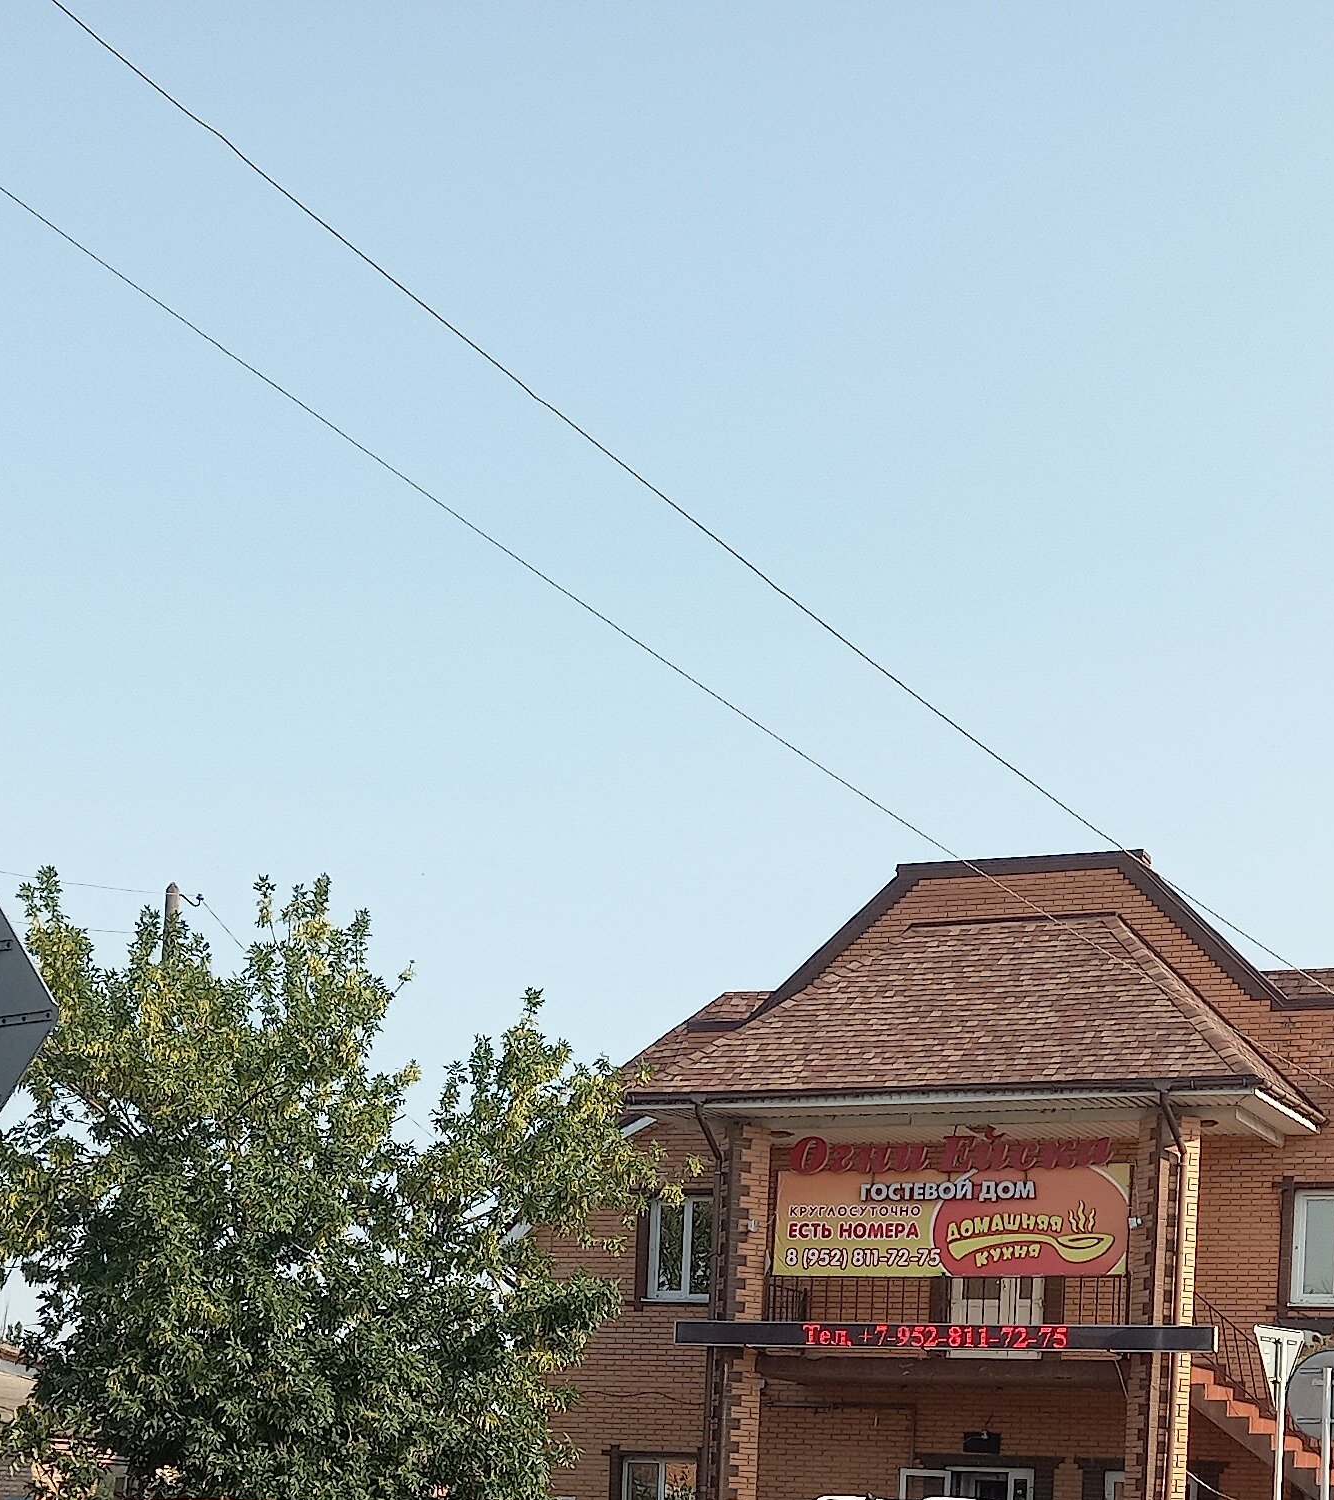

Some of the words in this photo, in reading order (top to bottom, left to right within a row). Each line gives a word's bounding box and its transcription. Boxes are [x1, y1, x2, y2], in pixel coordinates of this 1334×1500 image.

[790, 1136, 931, 1175] Огни
[937, 1125, 1114, 1173] Ейска
[860, 1178, 974, 1202] ГОСТЕВОЙ
[979, 1180, 1037, 1203] ДОМ
[789, 1205, 922, 1218] КРУГЛОСУТОЧНО
[788, 1222, 833, 1239] ЕСТЬ
[839, 1222, 919, 1239] НОМЕРА
[946, 1212, 1064, 1243] ДОМАШНЯЯ
[785, 1248, 798, 1266] 8
[802, 1248, 848, 1270] (952)
[852, 1248, 942, 1267] 811-72-75
[974, 1243, 1042, 1268] КУХНЯ
[858, 1324, 1069, 1348] +7-952-811-72-75
